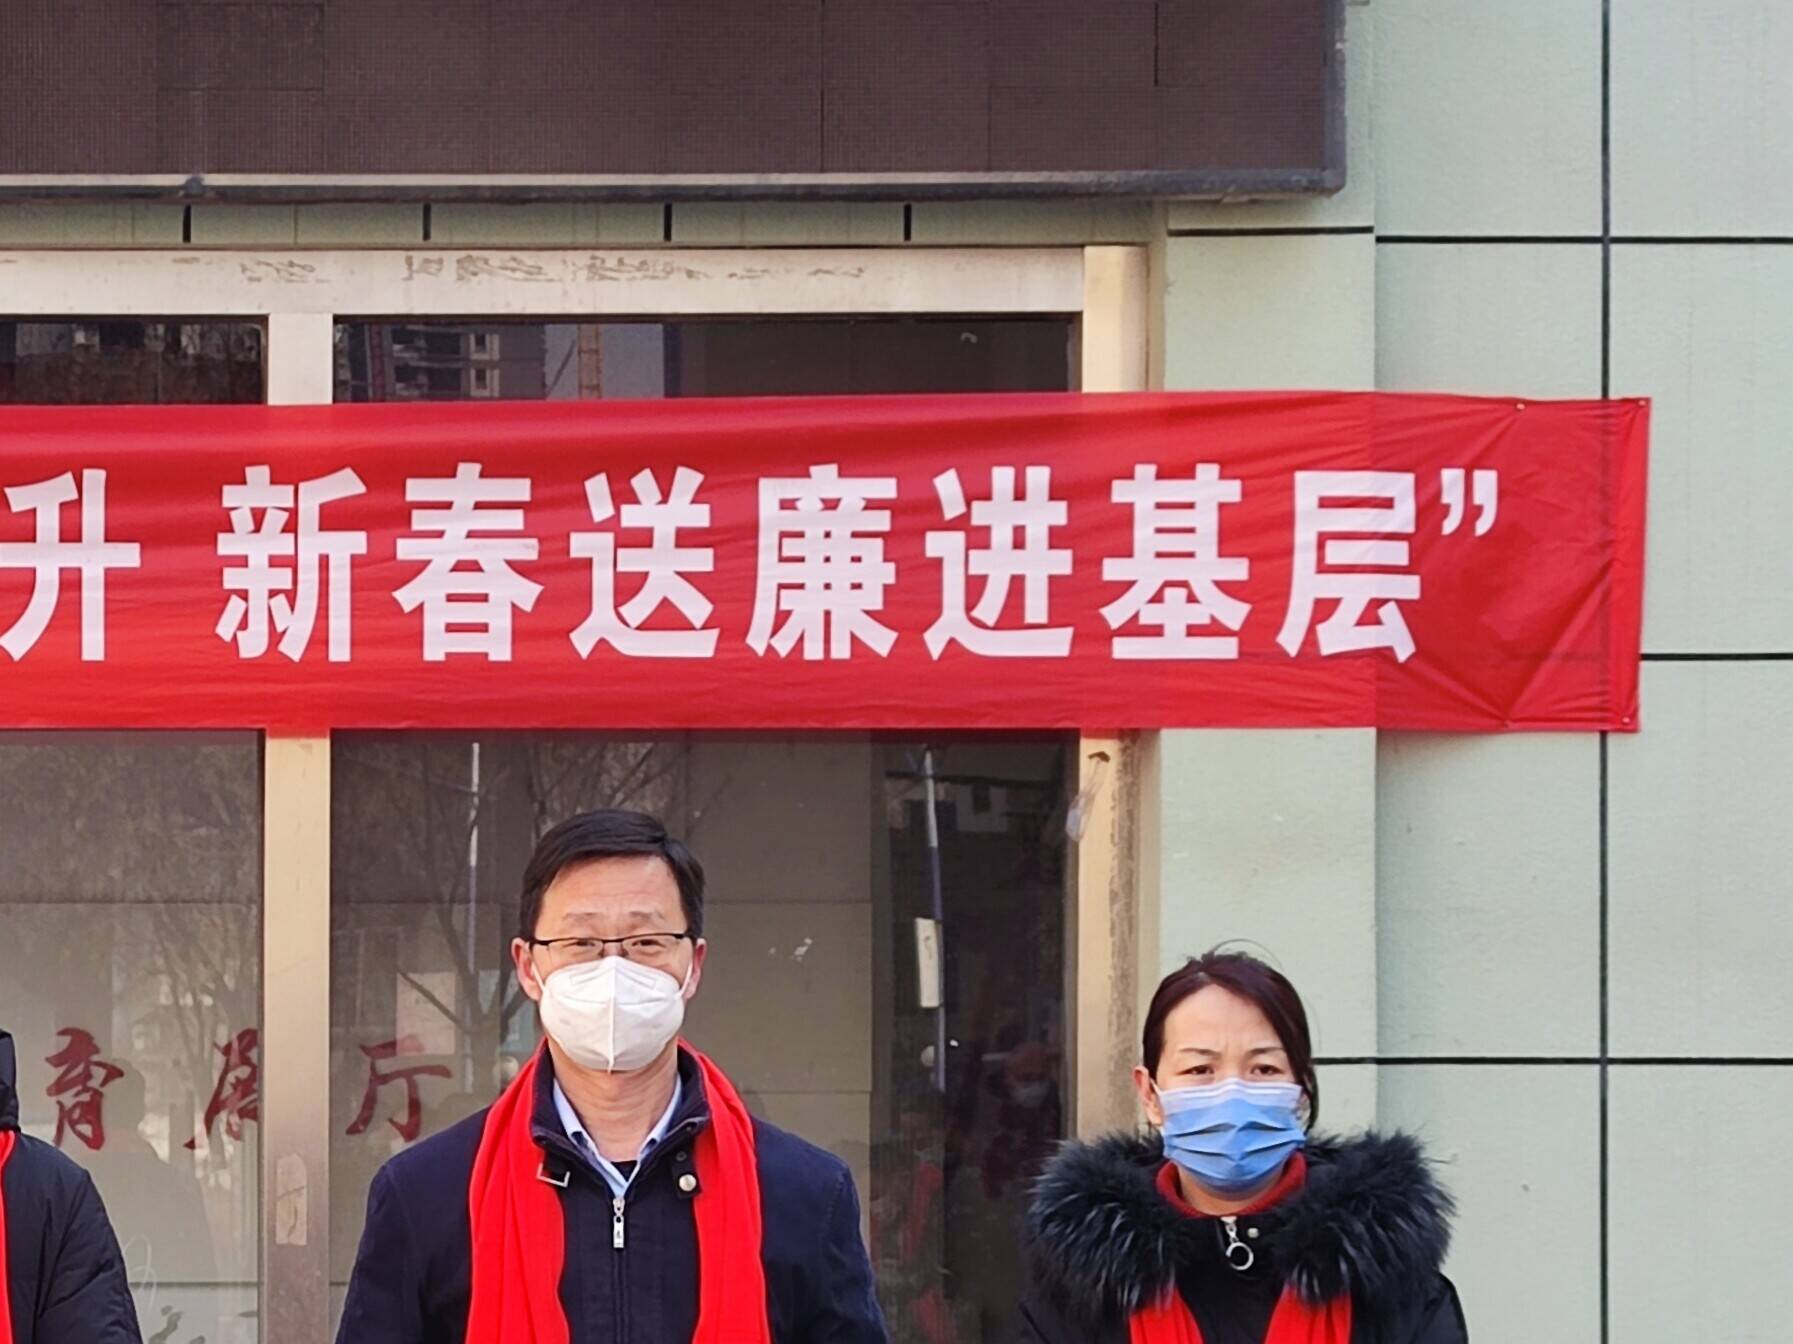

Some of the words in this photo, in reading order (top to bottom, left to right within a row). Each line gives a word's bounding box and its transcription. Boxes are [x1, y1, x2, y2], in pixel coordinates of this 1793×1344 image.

[216, 463, 1498, 662] 新春送廉进基层”
